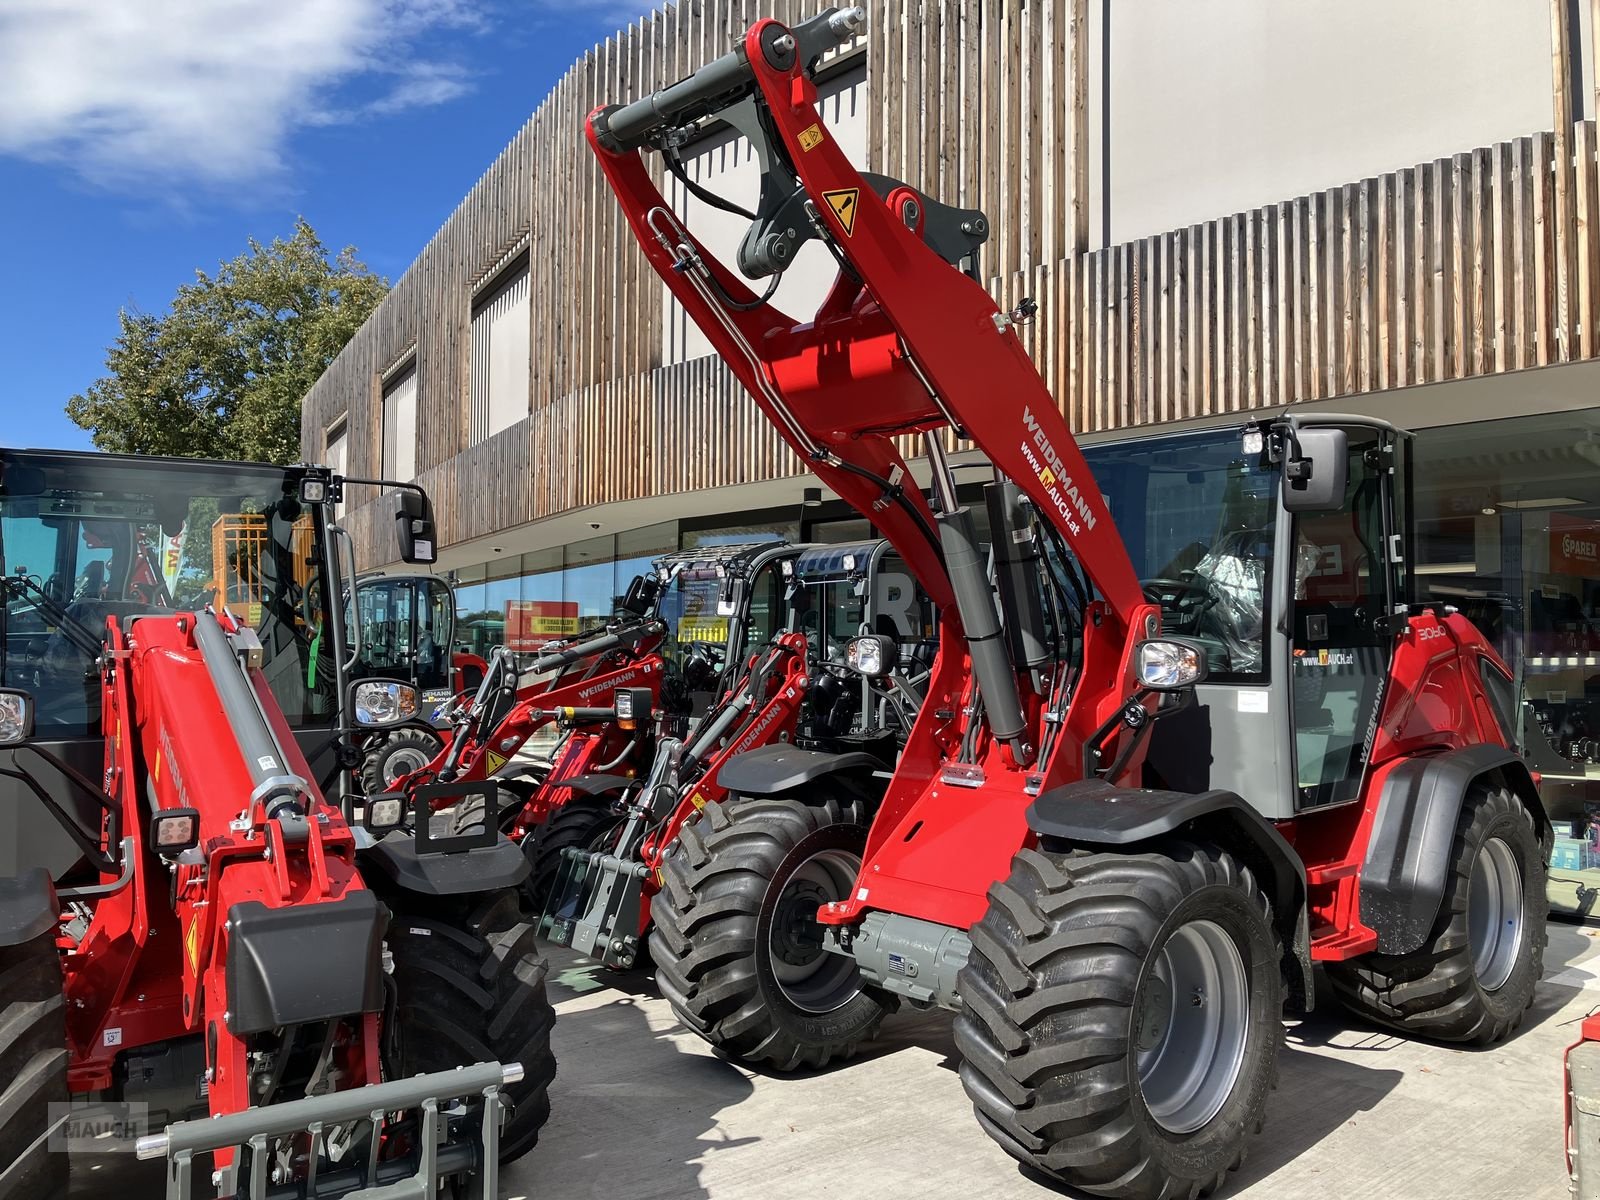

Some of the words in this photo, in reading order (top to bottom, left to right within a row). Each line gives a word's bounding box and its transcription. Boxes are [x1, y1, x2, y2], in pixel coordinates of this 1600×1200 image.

[1022, 404, 1097, 531] WEIDEMANN
[1020, 440, 1080, 537] www.MAUCH.at
[1562, 533, 1598, 558] SPAREX
[1417, 625, 1447, 641] 3060
[1302, 649, 1354, 666] www.MAUCH.at
[578, 670, 636, 699] WEIDEMANN
[1359, 677, 1385, 765] WEIDEMANN
